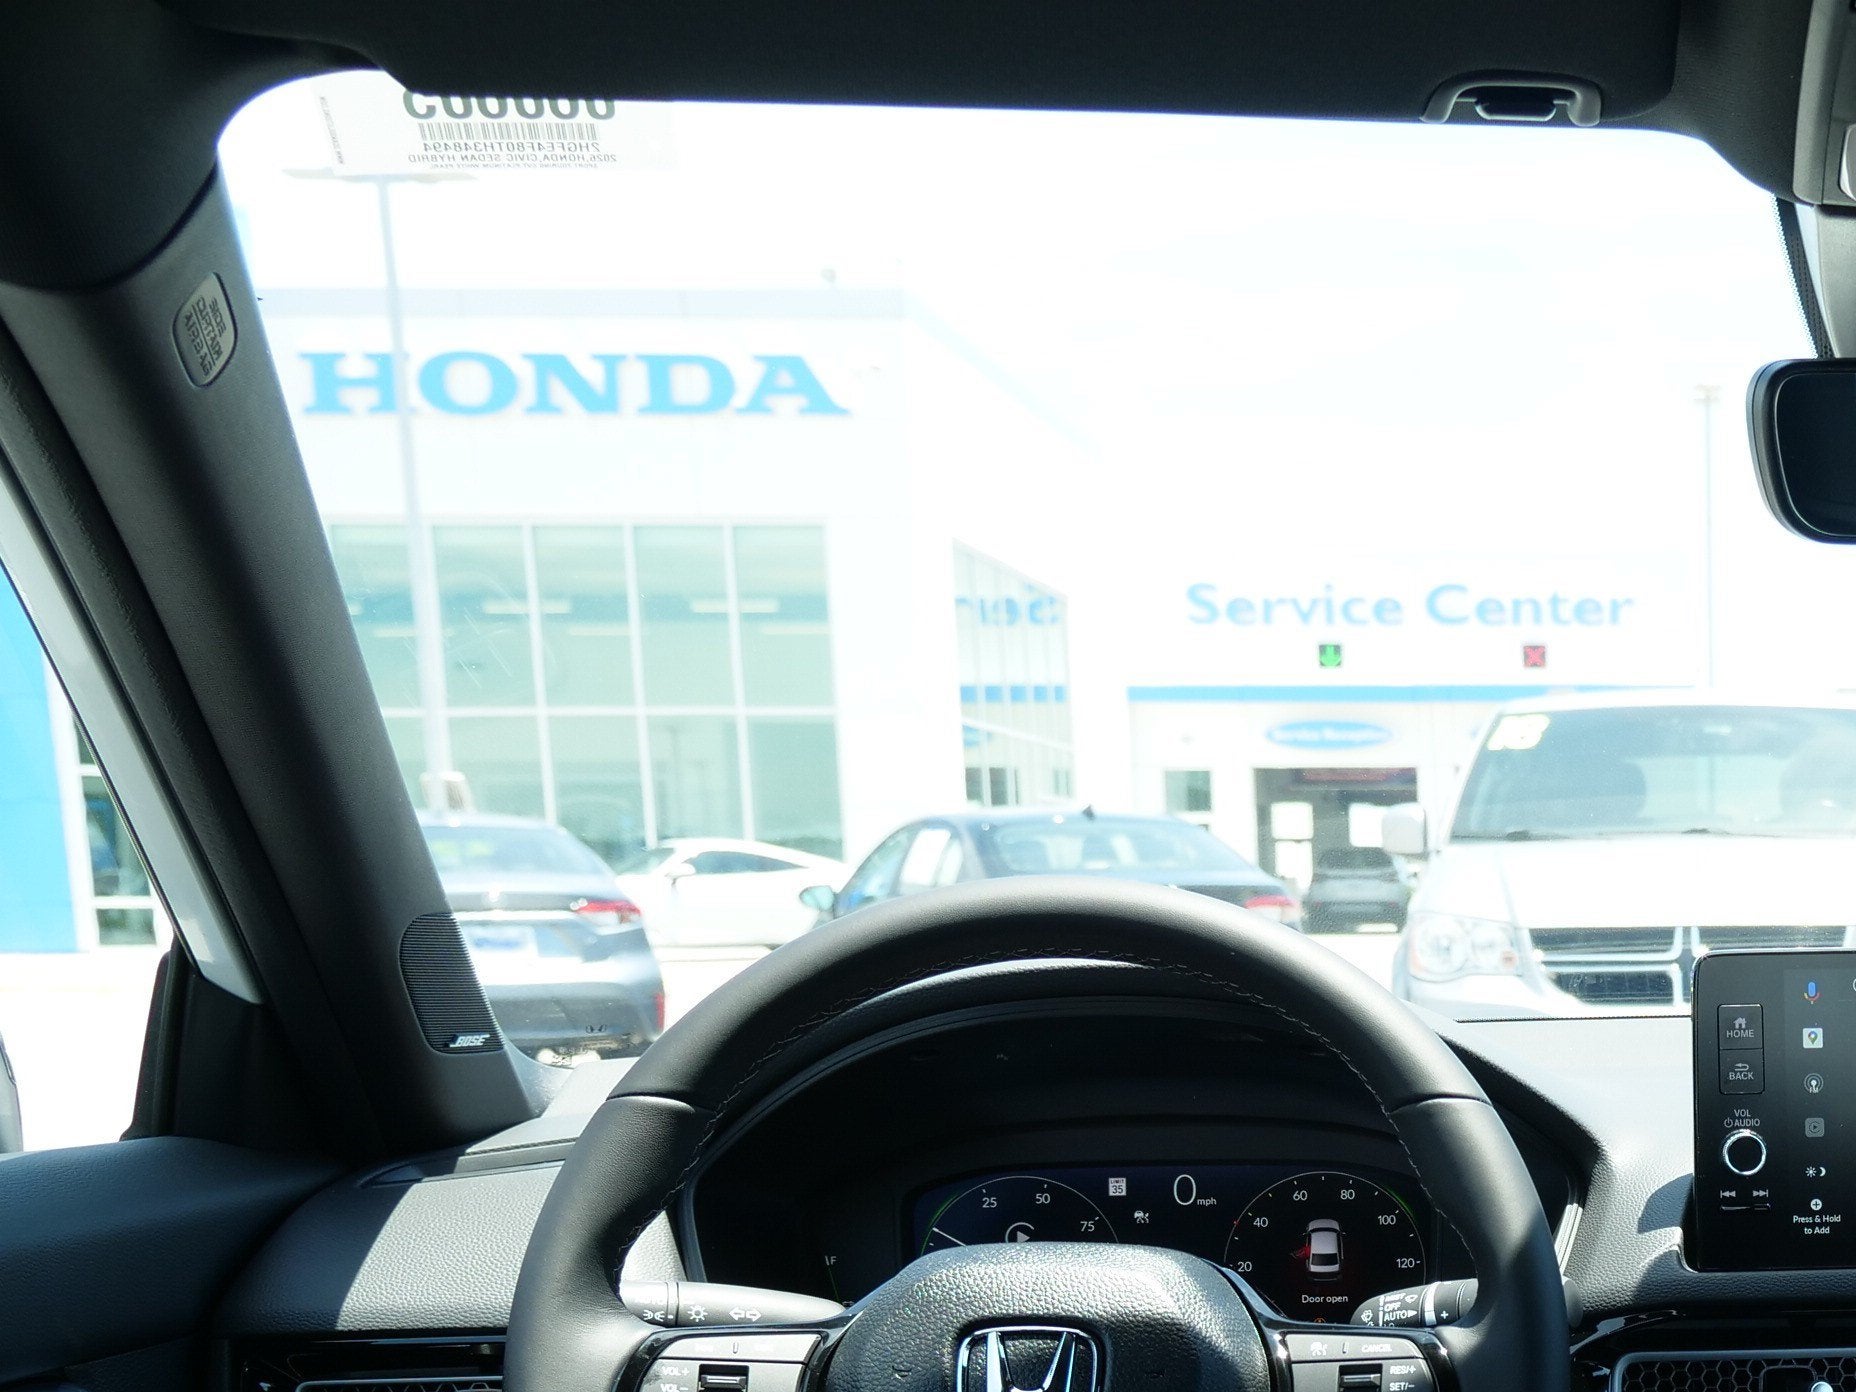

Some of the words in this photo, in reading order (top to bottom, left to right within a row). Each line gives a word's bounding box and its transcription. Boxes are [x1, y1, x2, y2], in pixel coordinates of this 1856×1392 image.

[299, 349, 854, 417] HONDA
[1185, 582, 1405, 627] Service
[1424, 583, 1636, 627] Center
[1726, 1030, 1754, 1038] HOME
[1729, 1071, 1754, 1080] BACK
[1734, 1109, 1751, 1117] VOL
[1734, 1118, 1760, 1127] AUDIO
[1112, 1185, 1124, 1194] 35
[1173, 1174, 1197, 1206] 0
[1035, 1193, 1051, 1204] 50
[1293, 1190, 1308, 1201] 60
[1340, 1190, 1355, 1200] 80
[982, 1198, 997, 1208] 25
[1197, 1197, 1217, 1206] mph
[1253, 1218, 1269, 1228] 40
[1378, 1215, 1397, 1225] 100
[1793, 1214, 1813, 1223] Press
[1815, 1214, 1821, 1223] &
[1823, 1214, 1841, 1223] Hold
[1080, 1221, 1095, 1232] 75
[1814, 1226, 1831, 1234] Add
[1237, 1262, 1252, 1272] 20
[1396, 1258, 1415, 1268] 120
[1302, 1295, 1325, 1303] Door
[1326, 1295, 1349, 1305] open
[1384, 1310, 1408, 1321] AUTO
